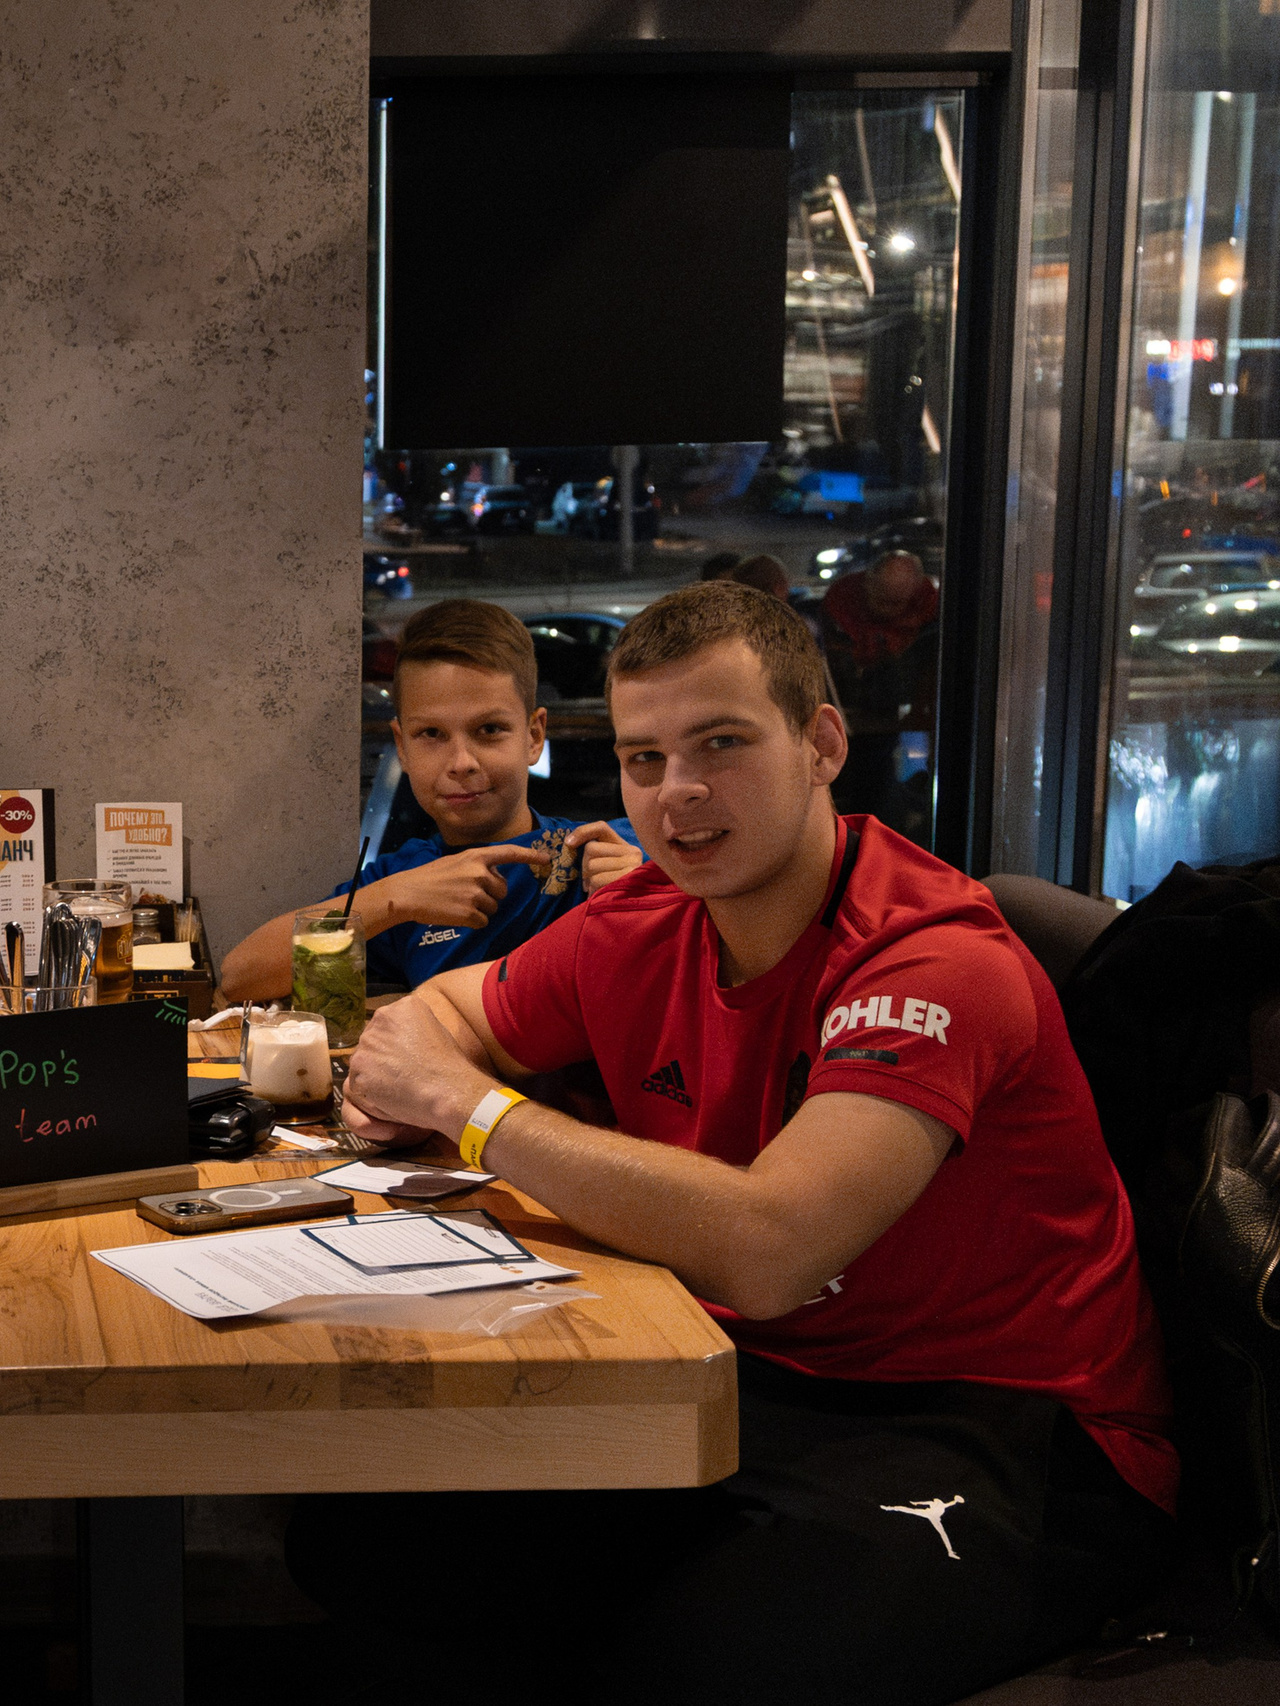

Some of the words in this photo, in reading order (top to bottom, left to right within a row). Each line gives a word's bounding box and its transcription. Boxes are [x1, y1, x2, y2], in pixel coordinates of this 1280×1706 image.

[0, 810, 33, 821] -30%
[109, 811, 149, 828] ПОЧЕМУ
[150, 812, 163, 825] ЭТО
[128, 827, 168, 843] УДОБНО?
[419, 928, 461, 946] JÖGEL
[641, 1078, 693, 1108] adidas
[14, 1108, 97, 1143] team
